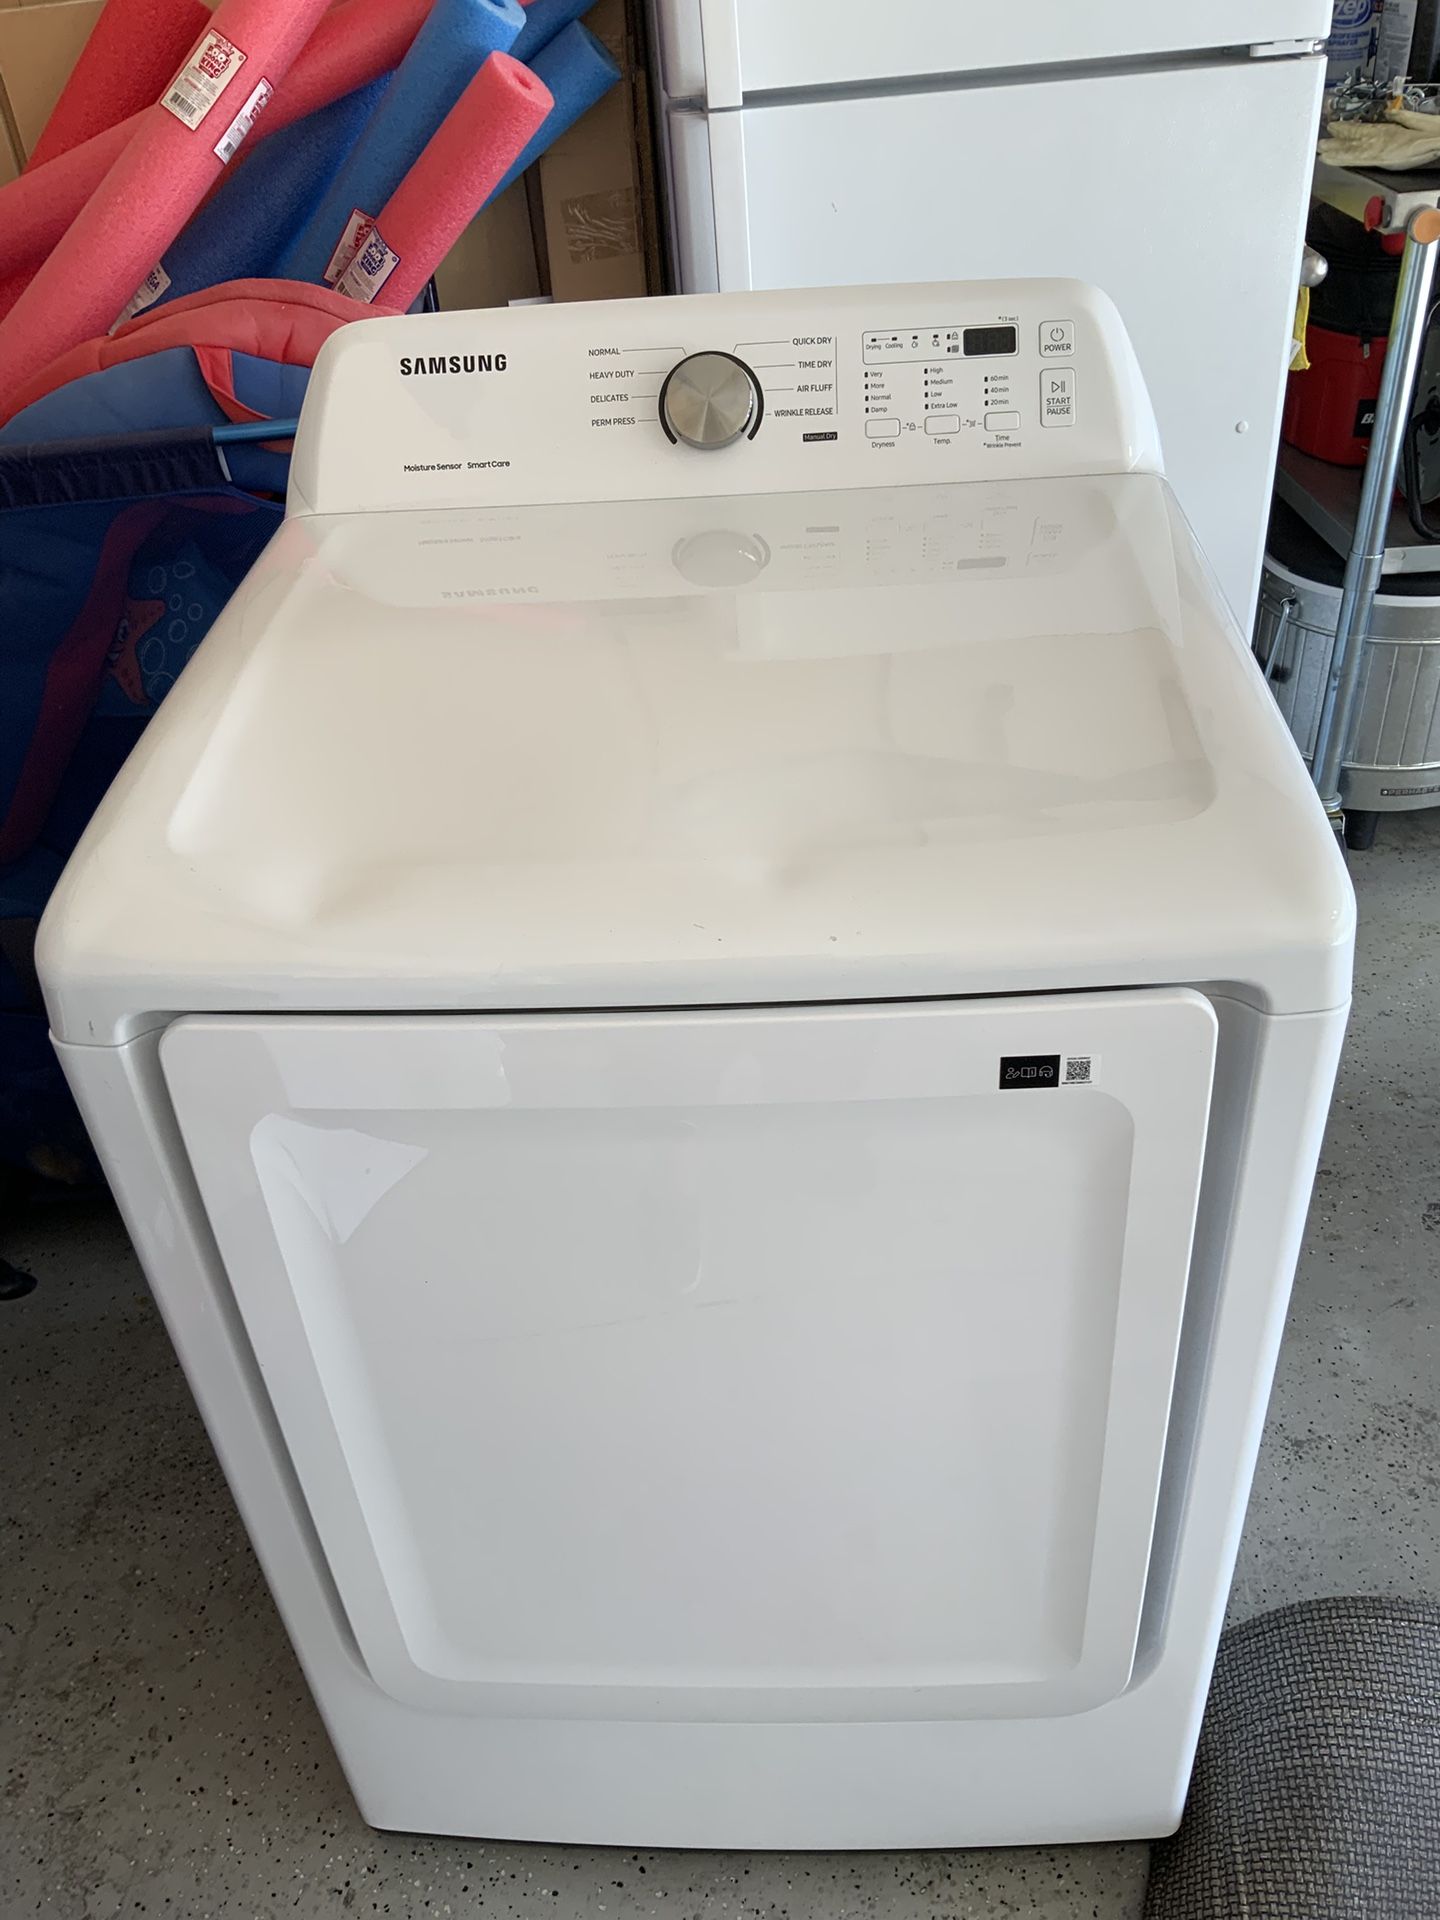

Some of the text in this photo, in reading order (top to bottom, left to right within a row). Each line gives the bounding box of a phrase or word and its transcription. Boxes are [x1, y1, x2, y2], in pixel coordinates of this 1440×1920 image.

[200, 57, 221, 76] KING
[792, 336, 833, 346] QUICK DRY
[588, 347, 621, 357] NORMAL
[1043, 343, 1072, 352] POWER
[399, 353, 507, 376] SAMSUNG
[817, 360, 833, 368] DRY
[589, 370, 635, 380] HEAVY DUTY
[796, 383, 833, 393] AIR FLUFF
[590, 394, 629, 403] DELICATES
[1046, 397, 1071, 405] START
[774, 407, 834, 417] WRINKLE RELEASE
[1046, 407, 1071, 415] PAUSE
[591, 417, 636, 427] PERM PRESS
[804, 432, 837, 441] Manual Dry
[871, 441, 896, 449] Dryness
[403, 464, 436, 472] Moisture
[436, 462, 462, 471] Sensor
